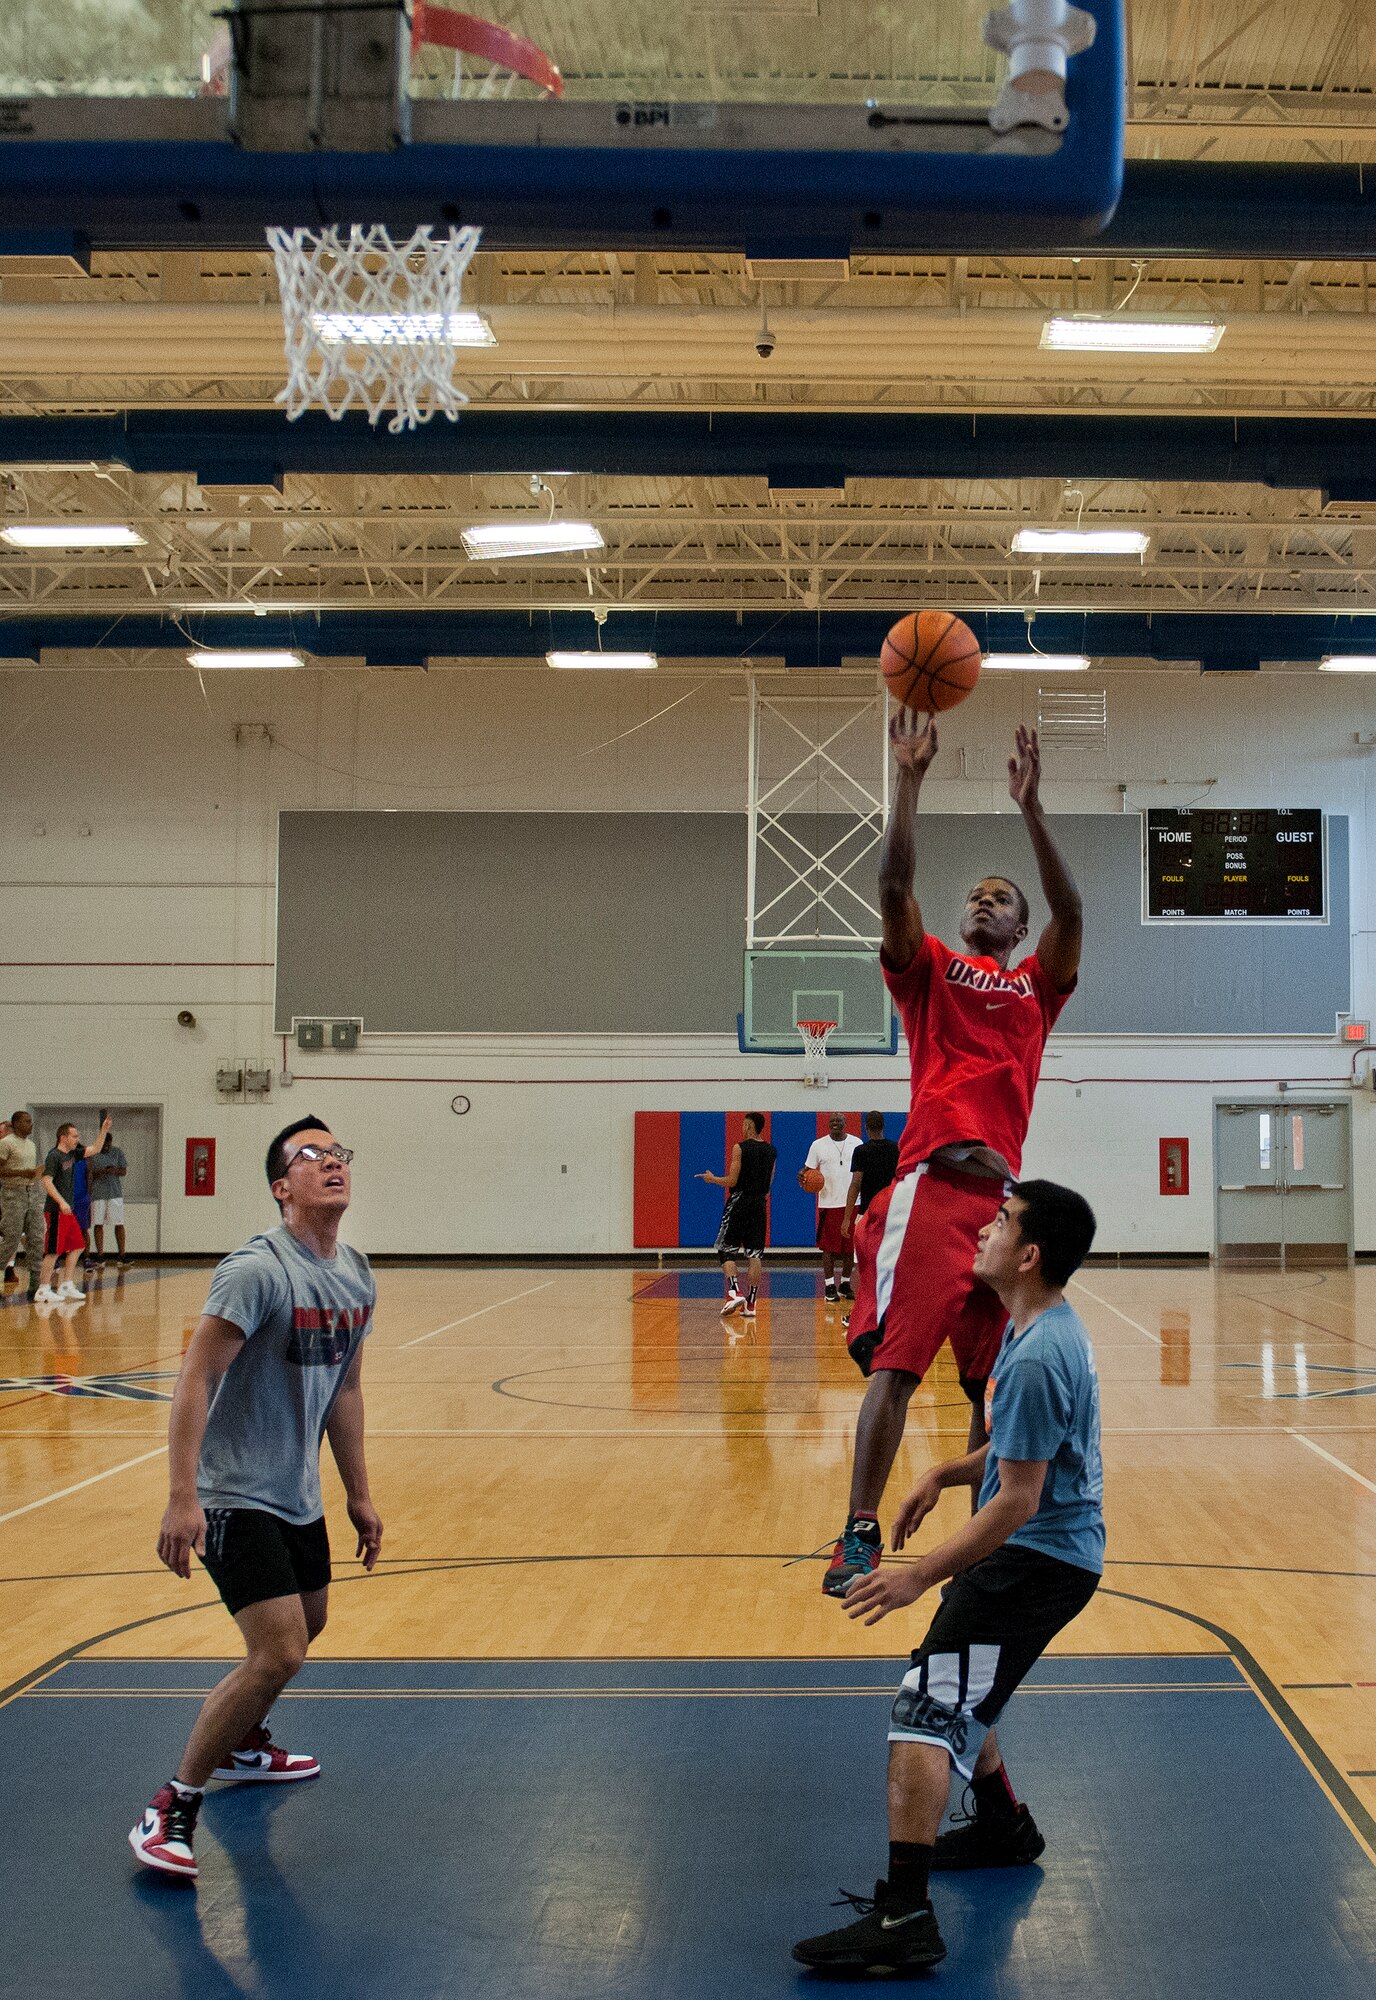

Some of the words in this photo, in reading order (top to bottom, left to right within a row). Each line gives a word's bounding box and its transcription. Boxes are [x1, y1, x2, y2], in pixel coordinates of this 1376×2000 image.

[1159, 831, 1192, 843] HOME
[1224, 835, 1248, 843] PERIOD
[1276, 831, 1314, 843] GUEST
[1226, 852, 1245, 860] POSS.
[1224, 862, 1247, 870] BONUS
